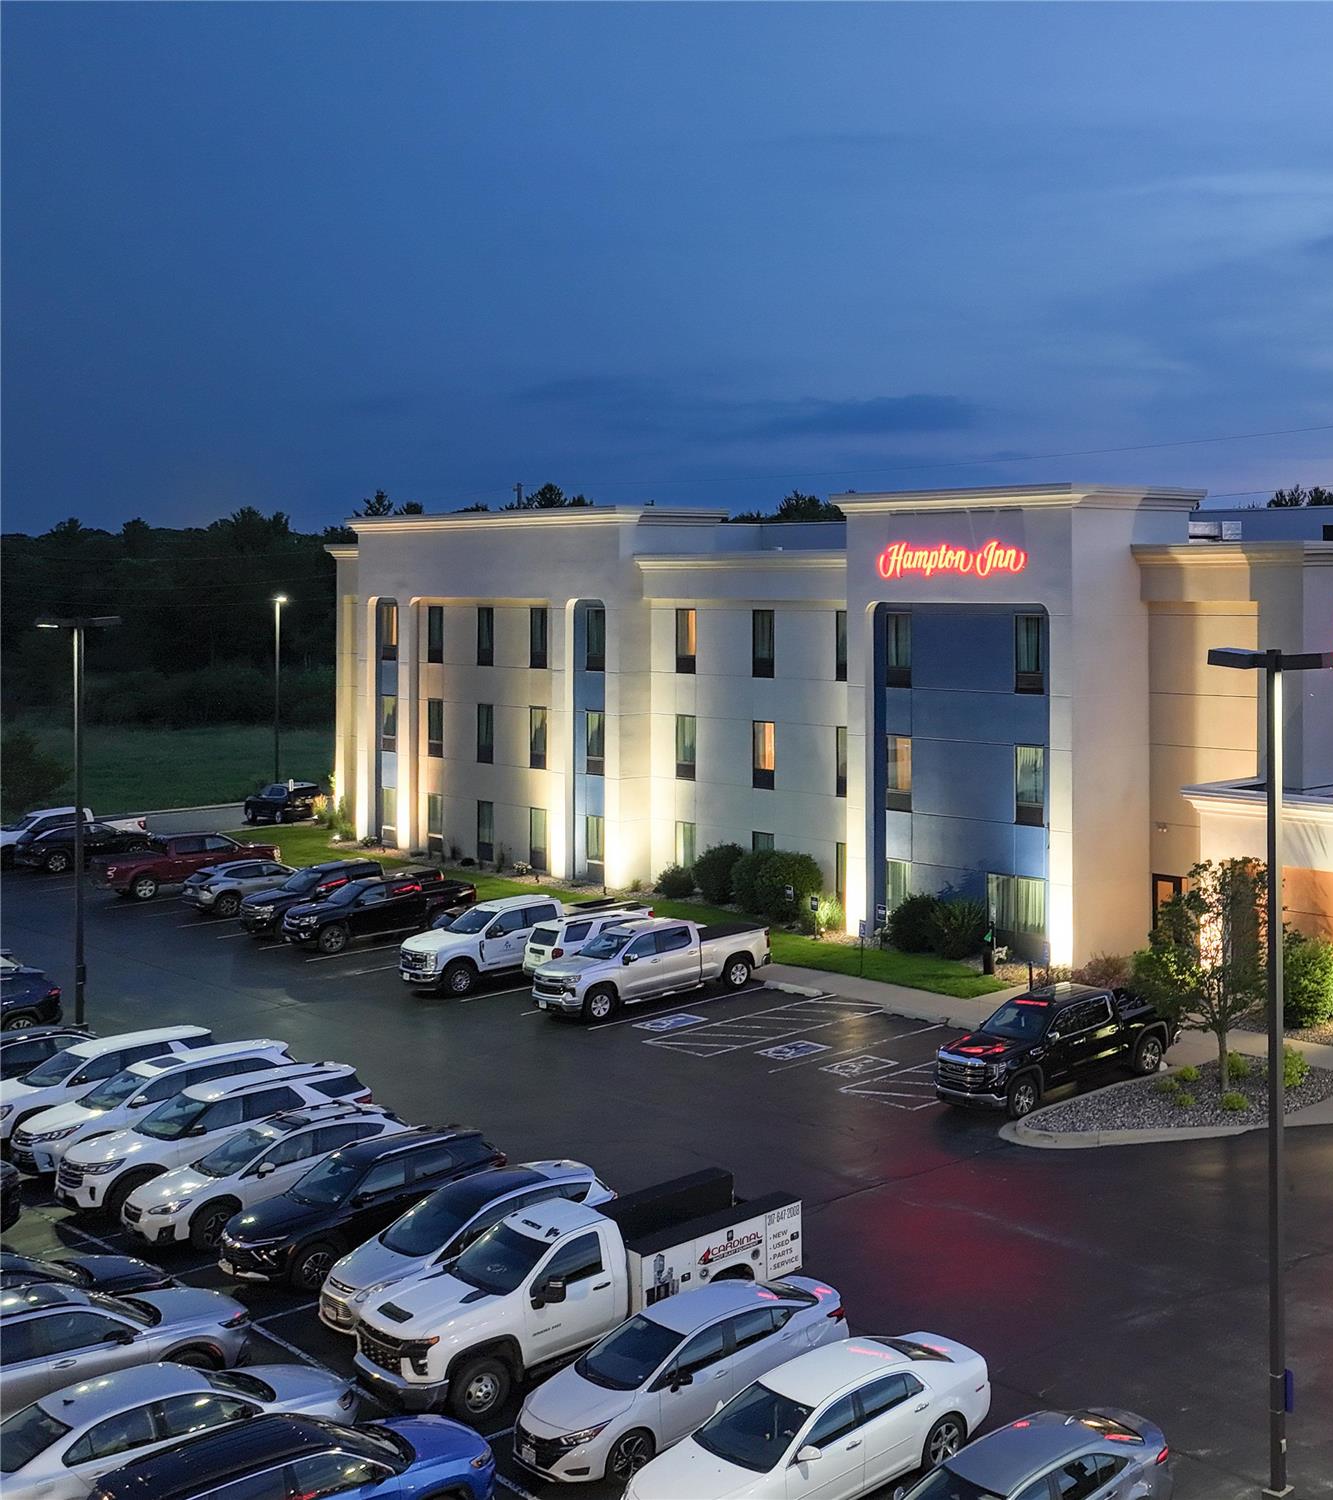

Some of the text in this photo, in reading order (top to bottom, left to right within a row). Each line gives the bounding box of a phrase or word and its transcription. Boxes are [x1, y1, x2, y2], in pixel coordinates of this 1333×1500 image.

[878, 540, 1026, 578] Hampton Inn
[772, 1229, 788, 1240] NEW
[711, 1231, 763, 1256] CARDINAL
[772, 1238, 790, 1250] USED
[772, 1247, 793, 1260] PARTS
[772, 1255, 799, 1270] SERVICE
